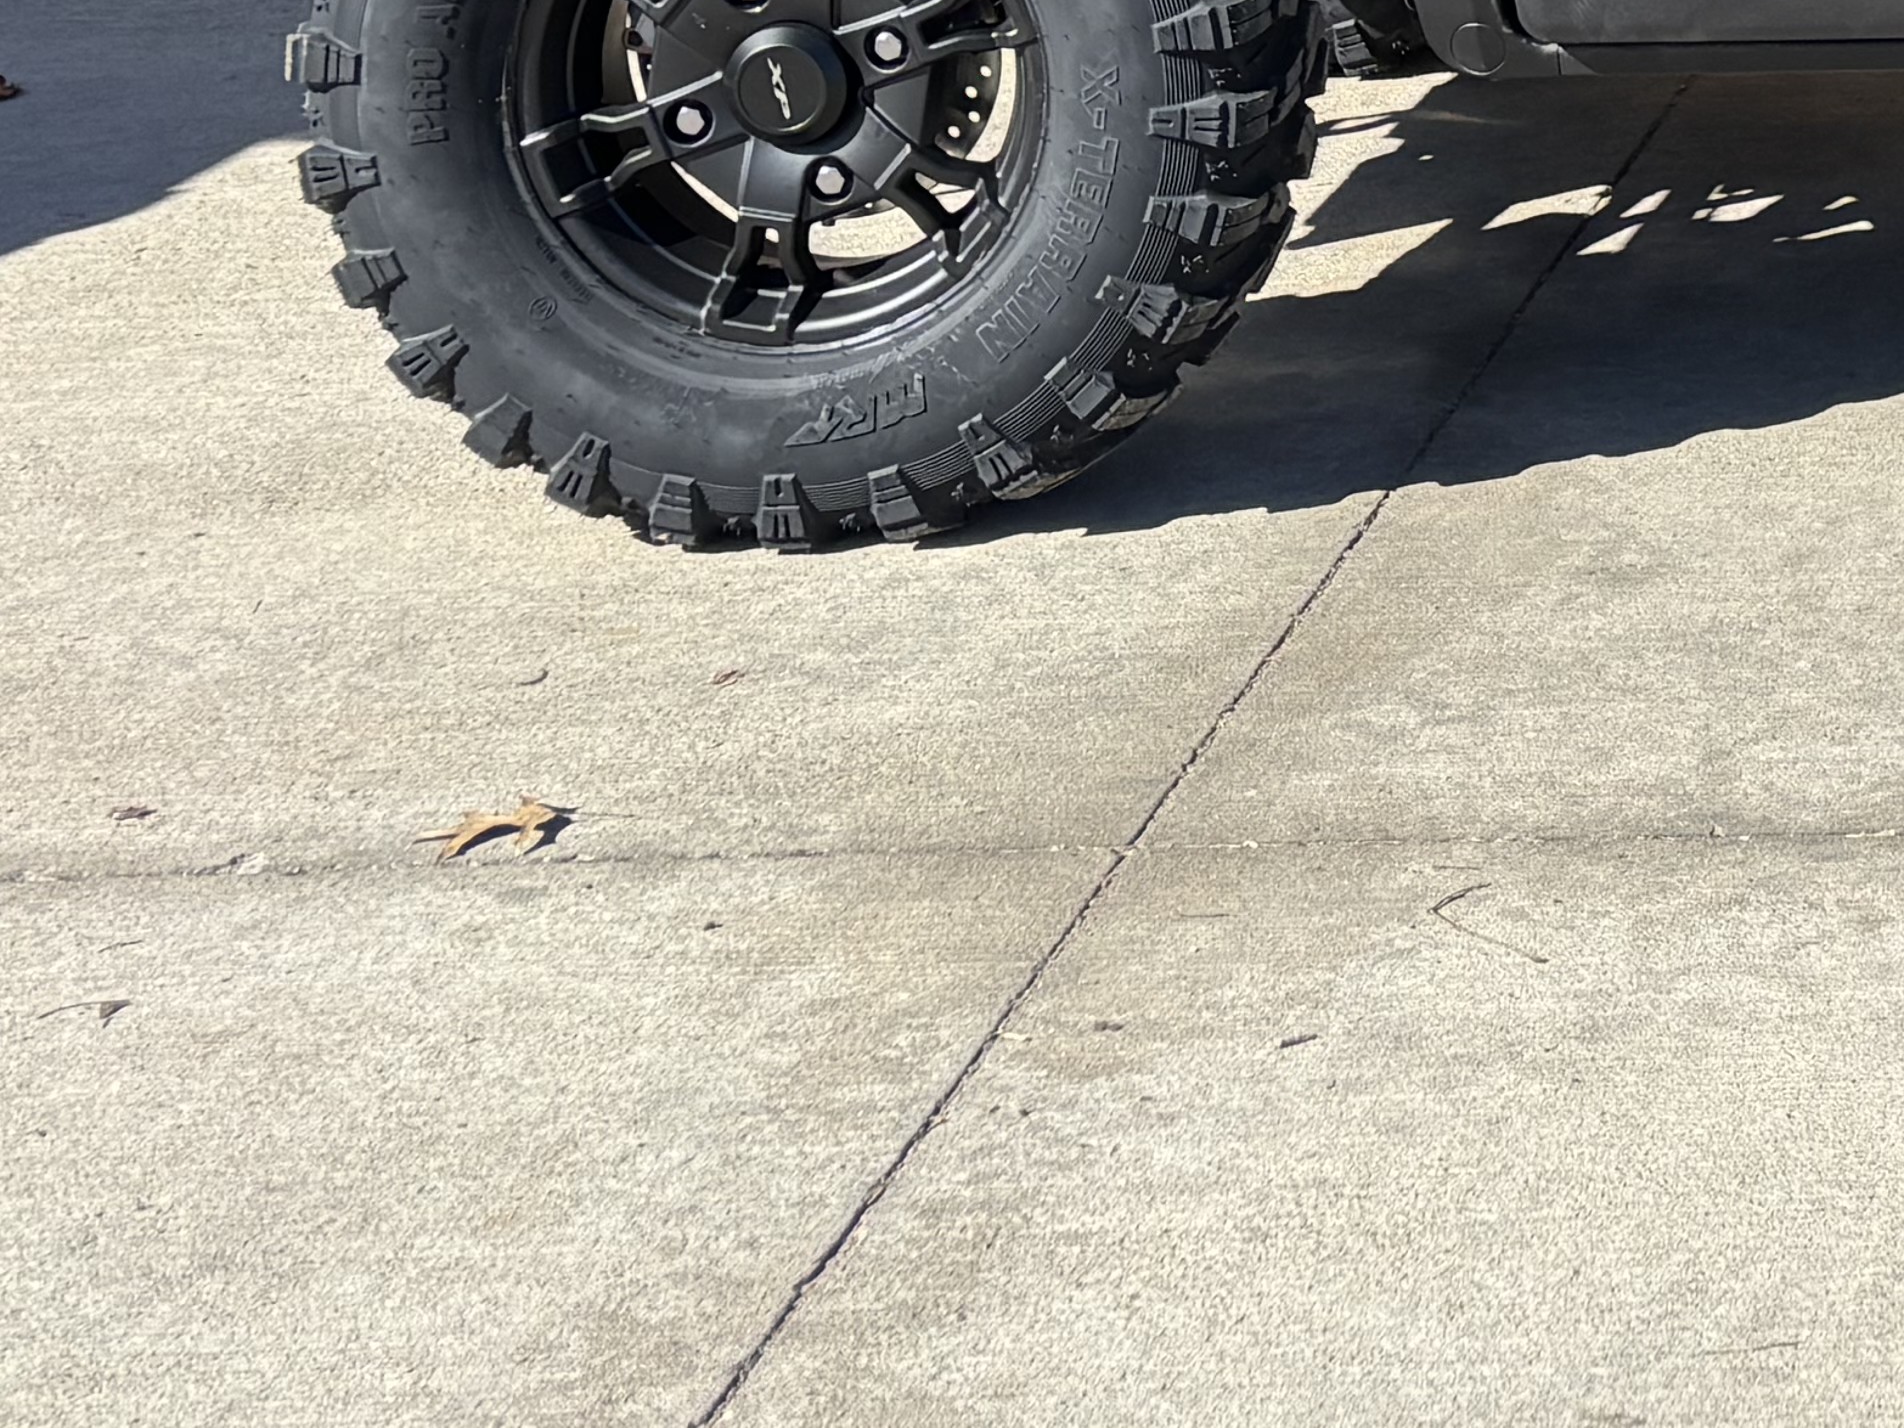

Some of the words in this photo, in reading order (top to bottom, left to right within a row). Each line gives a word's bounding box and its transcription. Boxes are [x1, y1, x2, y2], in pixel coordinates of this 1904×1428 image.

[405, 47, 449, 146] PRO
[766, 56, 791, 120] XP
[974, 64, 1122, 364] X-TERRAIN
